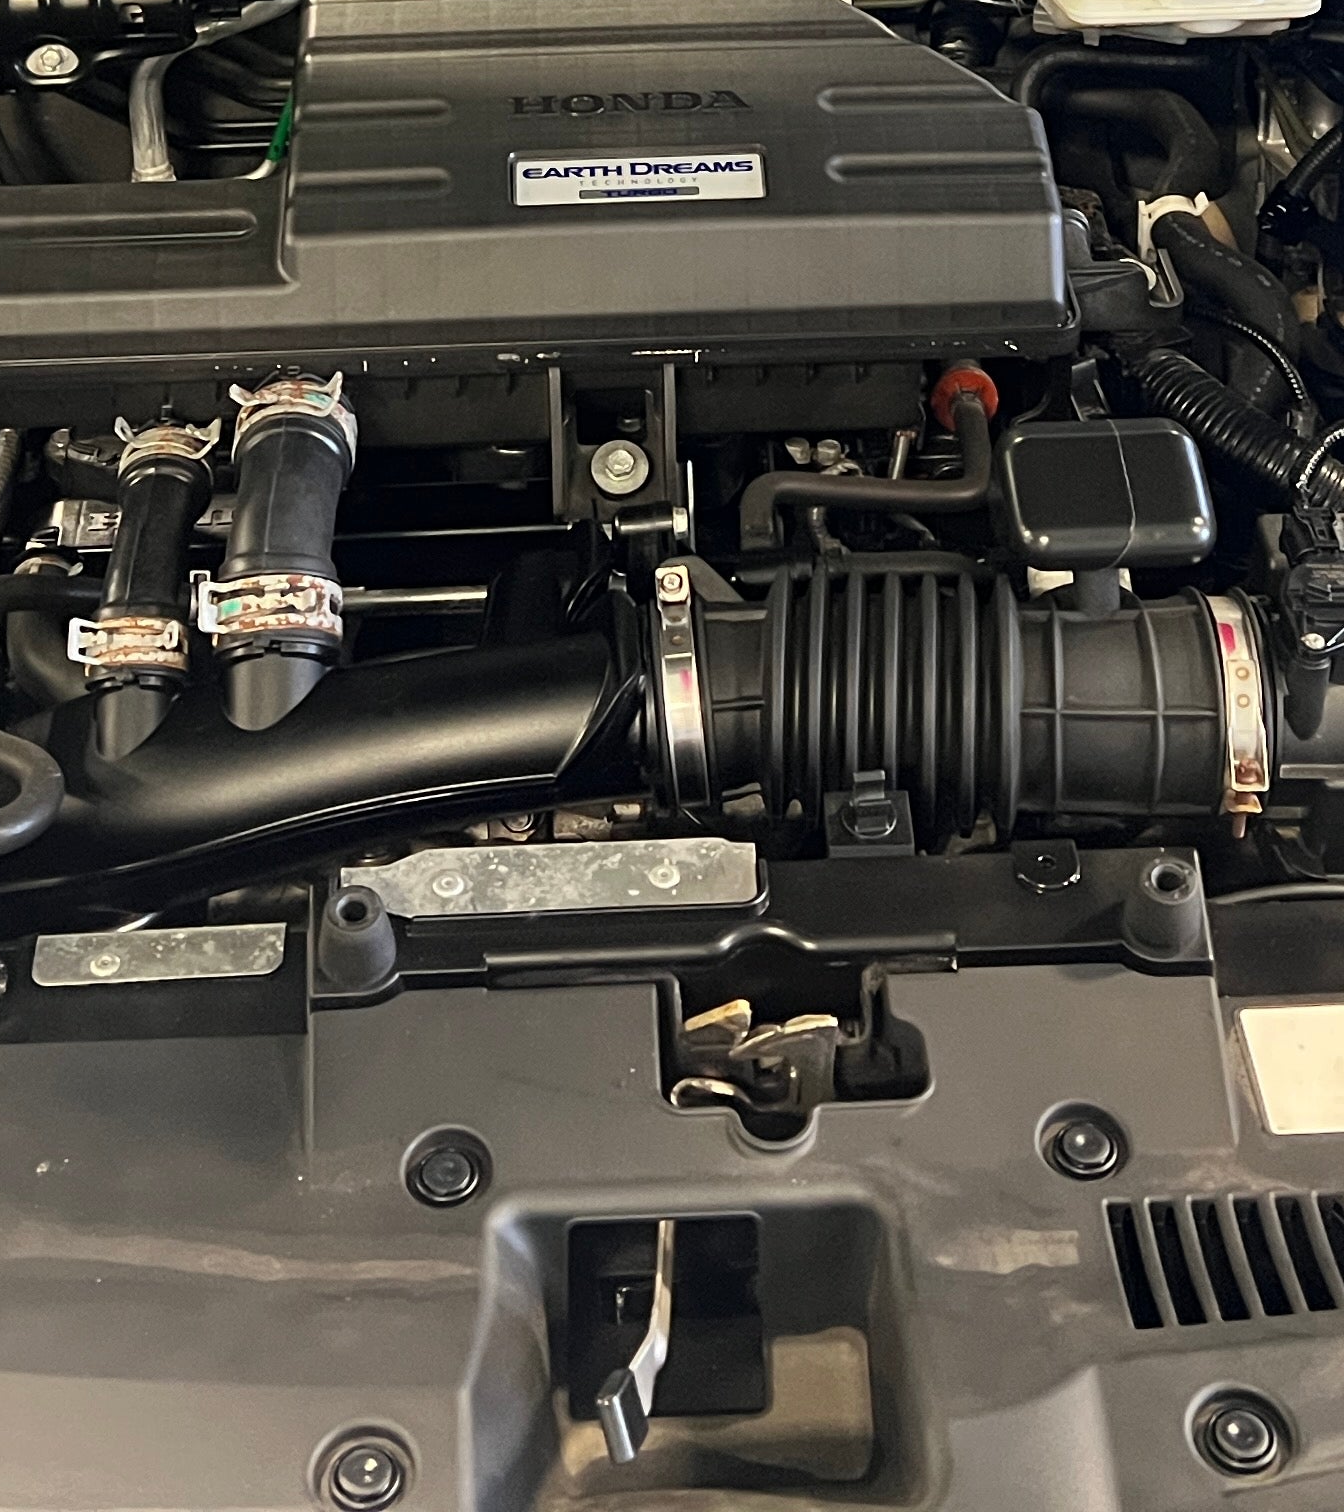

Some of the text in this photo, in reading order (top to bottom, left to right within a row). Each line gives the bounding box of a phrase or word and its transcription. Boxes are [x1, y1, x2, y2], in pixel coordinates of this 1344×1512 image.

[509, 90, 754, 115] HONDA
[522, 160, 754, 179] EARTH DREAMS
[579, 177, 698, 186] TECHNOLOGY
